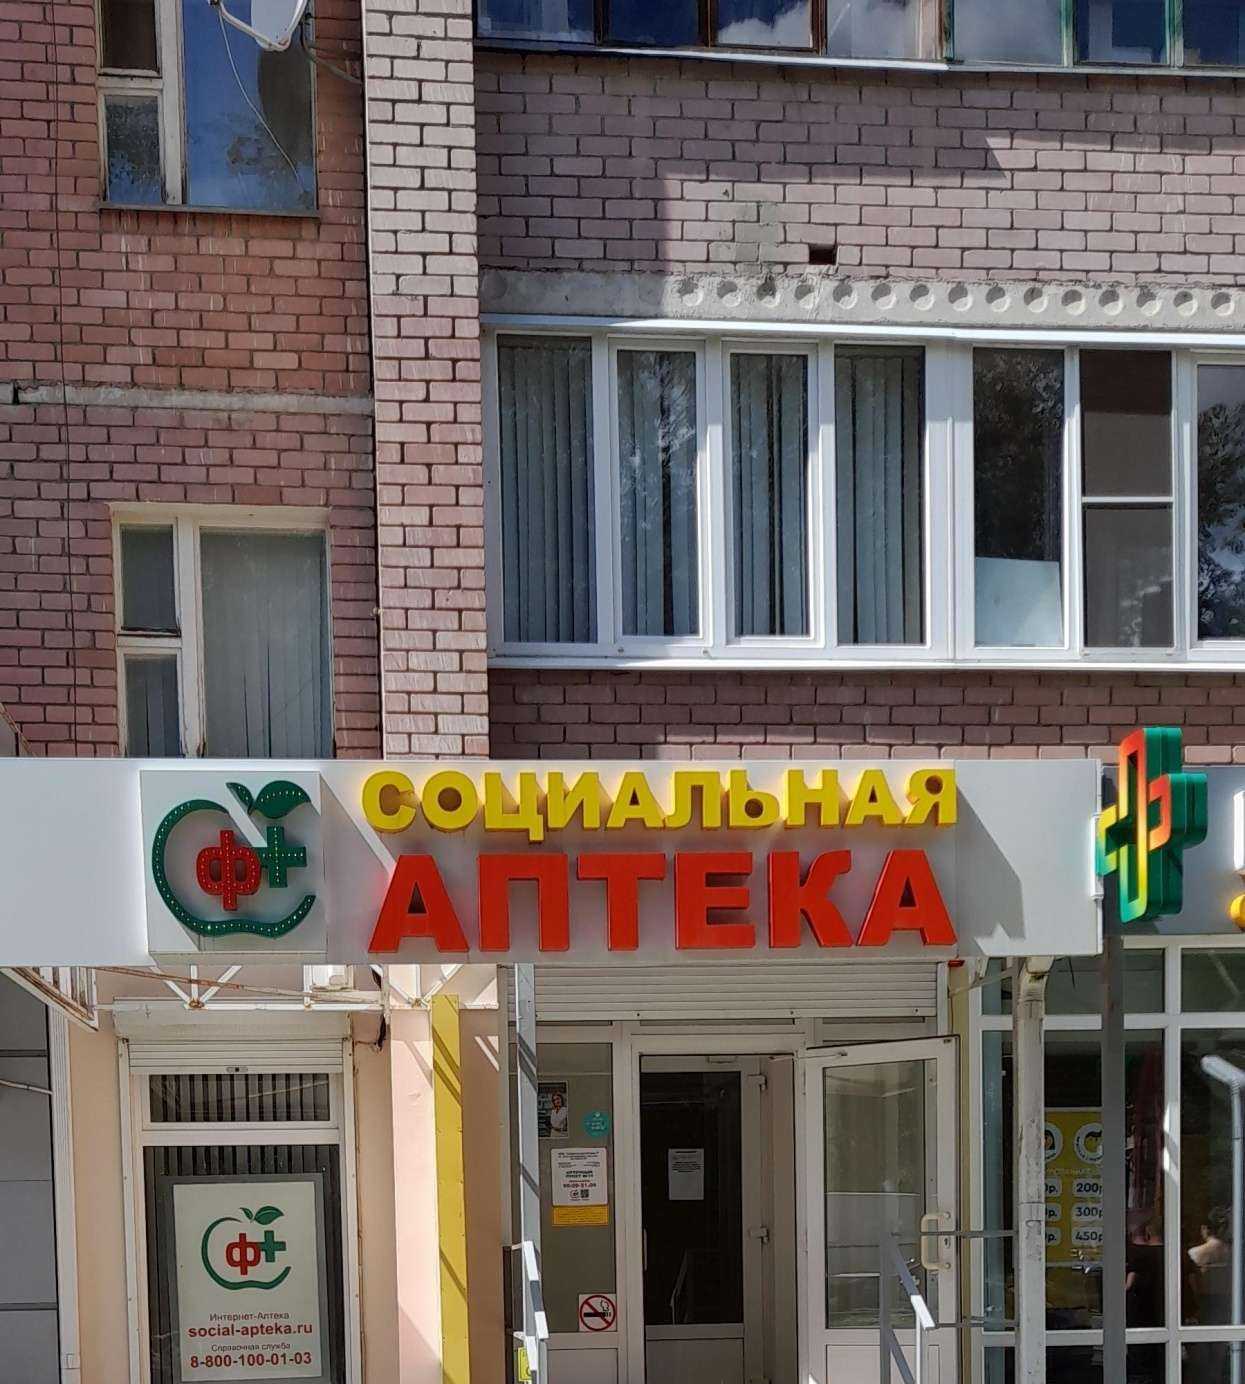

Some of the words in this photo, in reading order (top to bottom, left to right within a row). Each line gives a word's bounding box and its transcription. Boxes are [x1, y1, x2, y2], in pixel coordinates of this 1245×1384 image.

[361, 768, 958, 842] СОЦИАЛЬНАЯ
[368, 849, 958, 954] АПТЕКА
[209, 1311, 290, 1322] Интернет-Аптека
[187, 1322, 313, 1338] social-apteka.ru
[211, 1344, 260, 1352] Справочная
[261, 1342, 291, 1352] служба
[189, 1352, 313, 1369] 8-800-100-01-03
